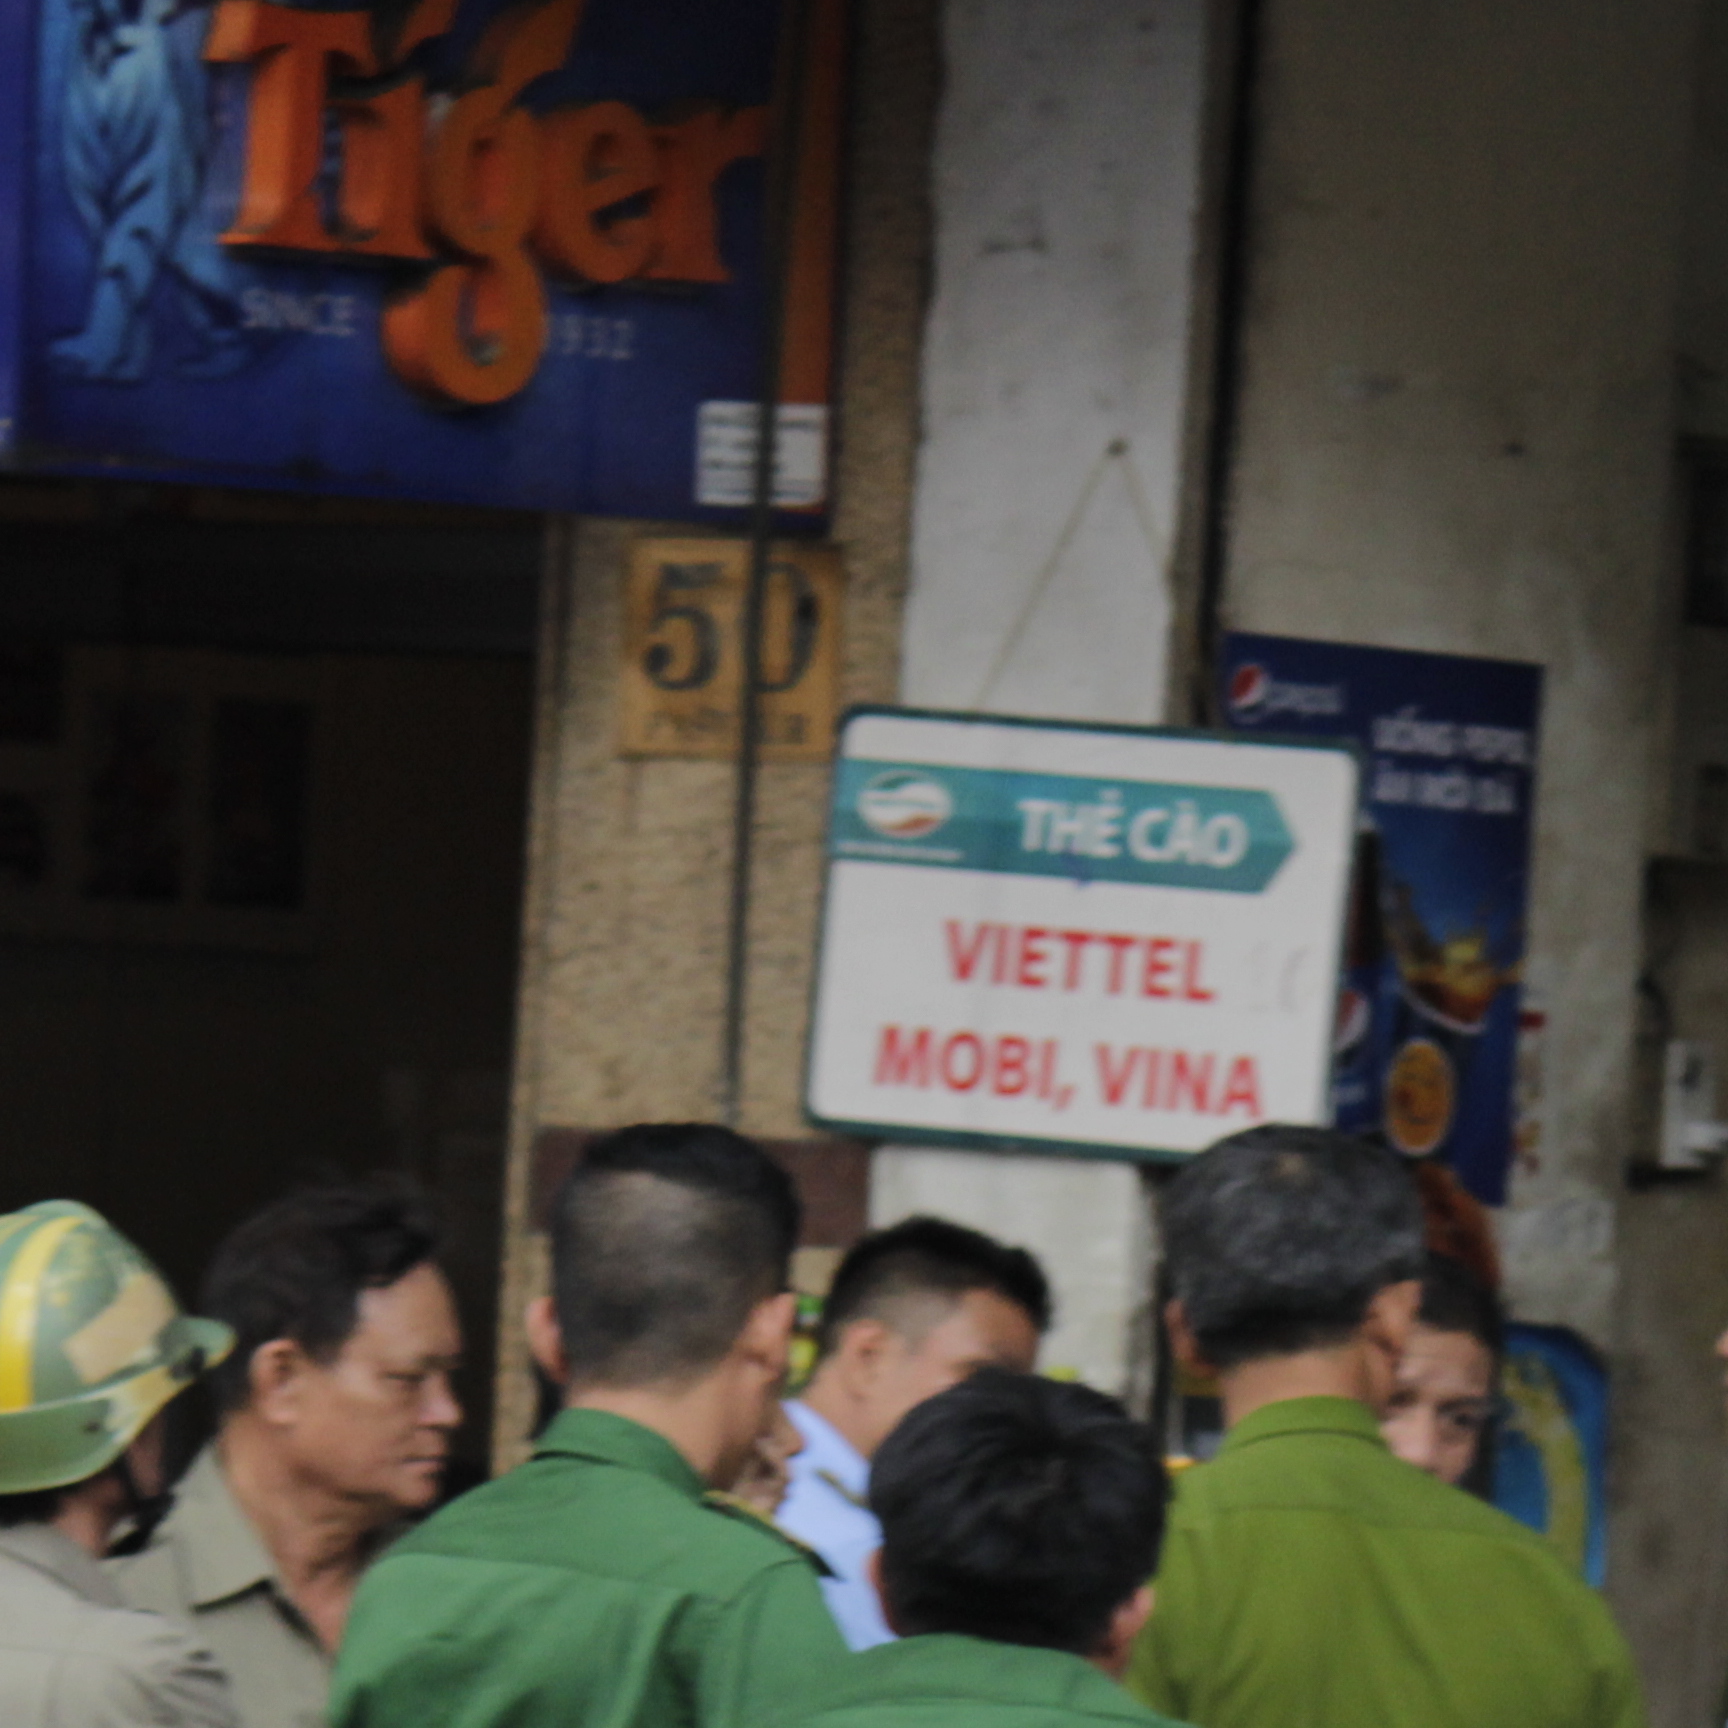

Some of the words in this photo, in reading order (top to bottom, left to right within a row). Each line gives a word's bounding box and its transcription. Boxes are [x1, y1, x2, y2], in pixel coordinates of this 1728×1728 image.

[203, 0, 775, 403] Tiger
[238, 287, 362, 338] SINCE
[640, 562, 820, 692] 50
[945, 920, 1216, 1003] VIETTEL
[874, 1026, 1076, 1111] MOBI,
[1095, 1044, 1263, 1117] VINA
